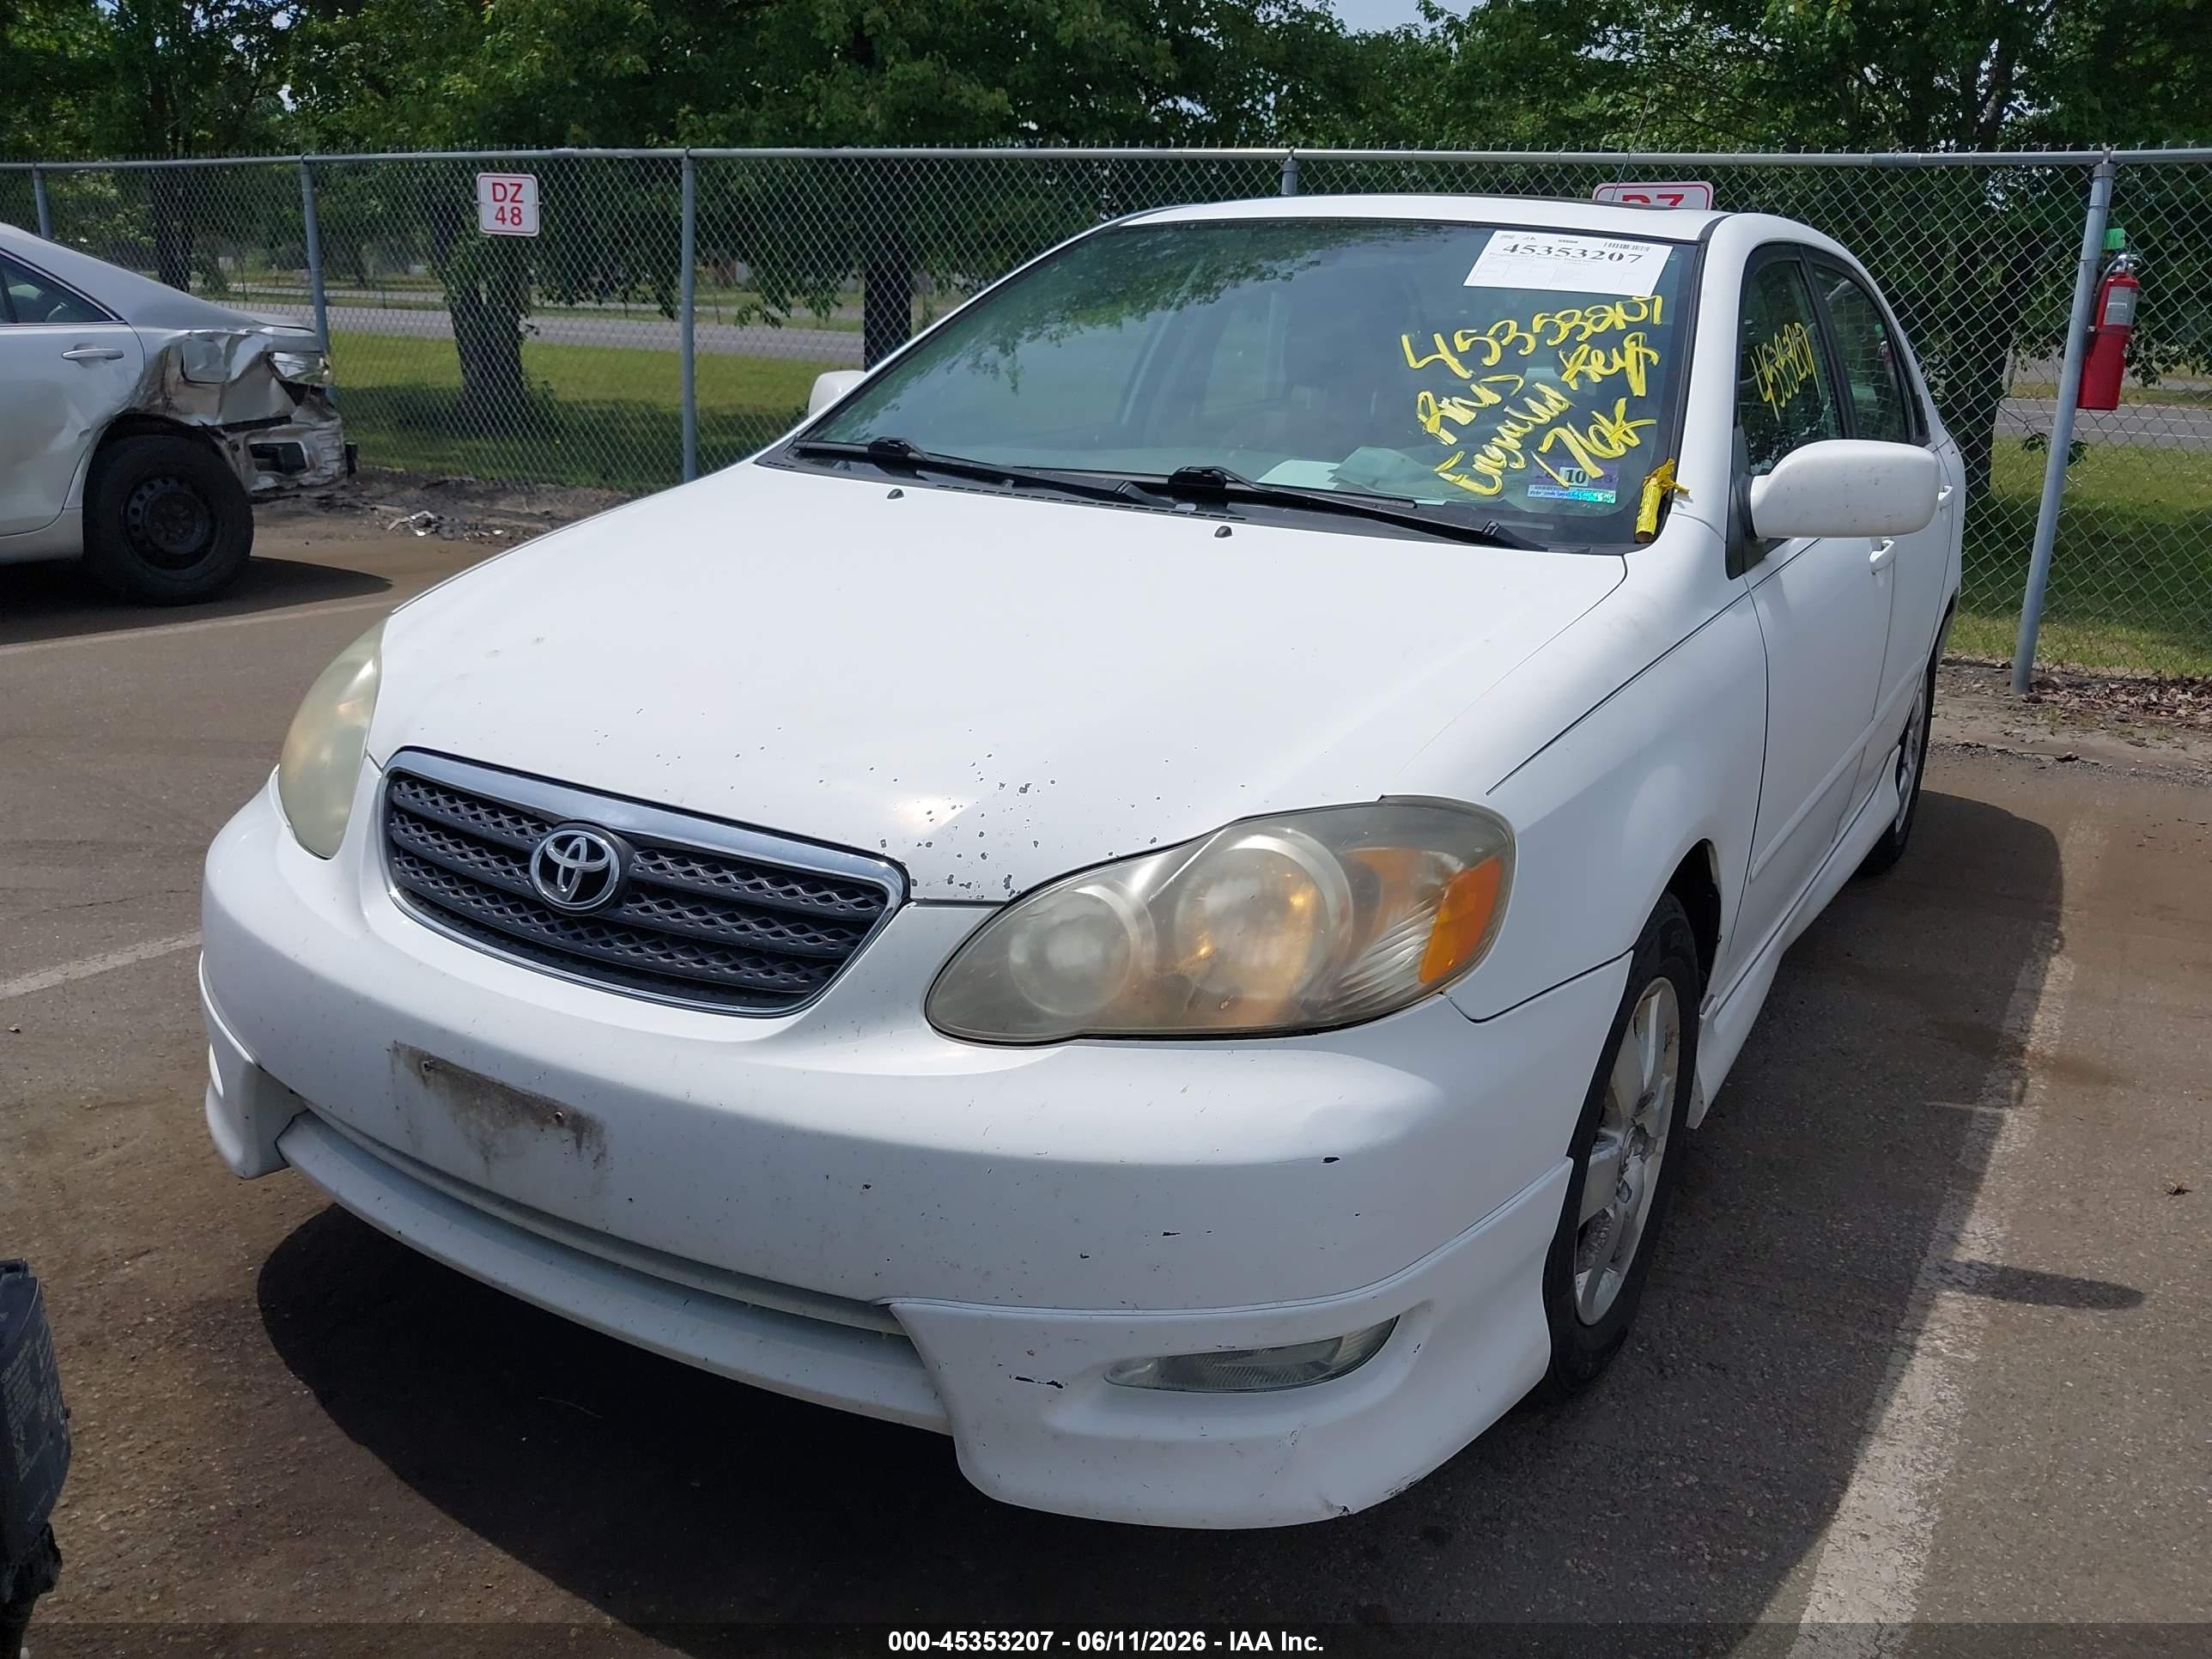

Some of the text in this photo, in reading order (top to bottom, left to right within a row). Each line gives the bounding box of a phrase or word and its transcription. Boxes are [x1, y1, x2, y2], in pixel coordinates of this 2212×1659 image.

[492, 182, 524, 204] DZ
[495, 205, 522, 227] 48
[1503, 243, 1644, 264] 45353207
[1565, 469, 1587, 484] 10
